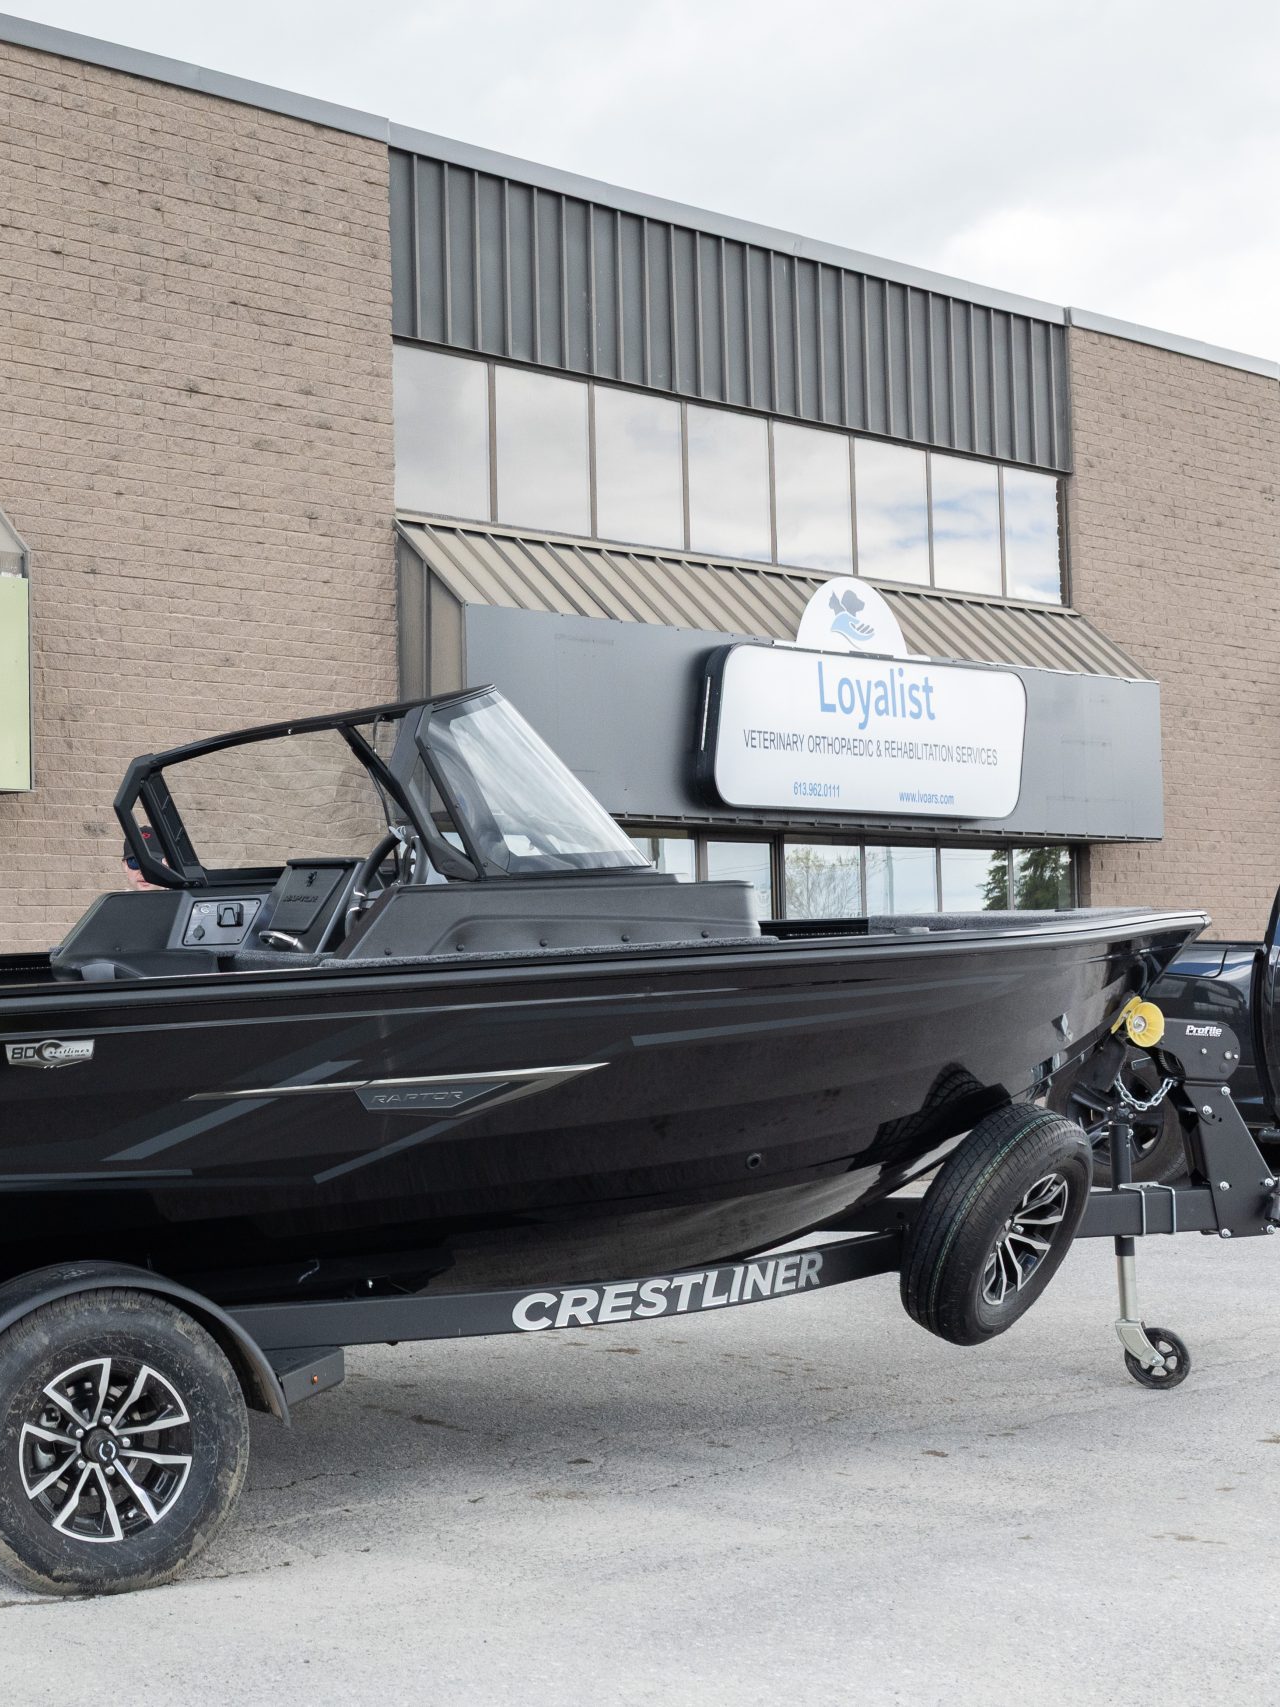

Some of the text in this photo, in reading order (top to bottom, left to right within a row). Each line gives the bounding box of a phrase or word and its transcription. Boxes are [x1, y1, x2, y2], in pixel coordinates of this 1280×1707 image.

[817, 660, 937, 730] Loyalist
[743, 728, 999, 766] VETERINARY ORTHOPAEDIC & REHABILITATION SERVICES
[793, 781, 841, 798] 613.962.0111
[899, 788, 955, 806] www.lvoars.com
[1185, 1024, 1223, 1036] Profile
[371, 1090, 464, 1104] RAPTOR
[511, 1251, 824, 1332] CRESTLINER
